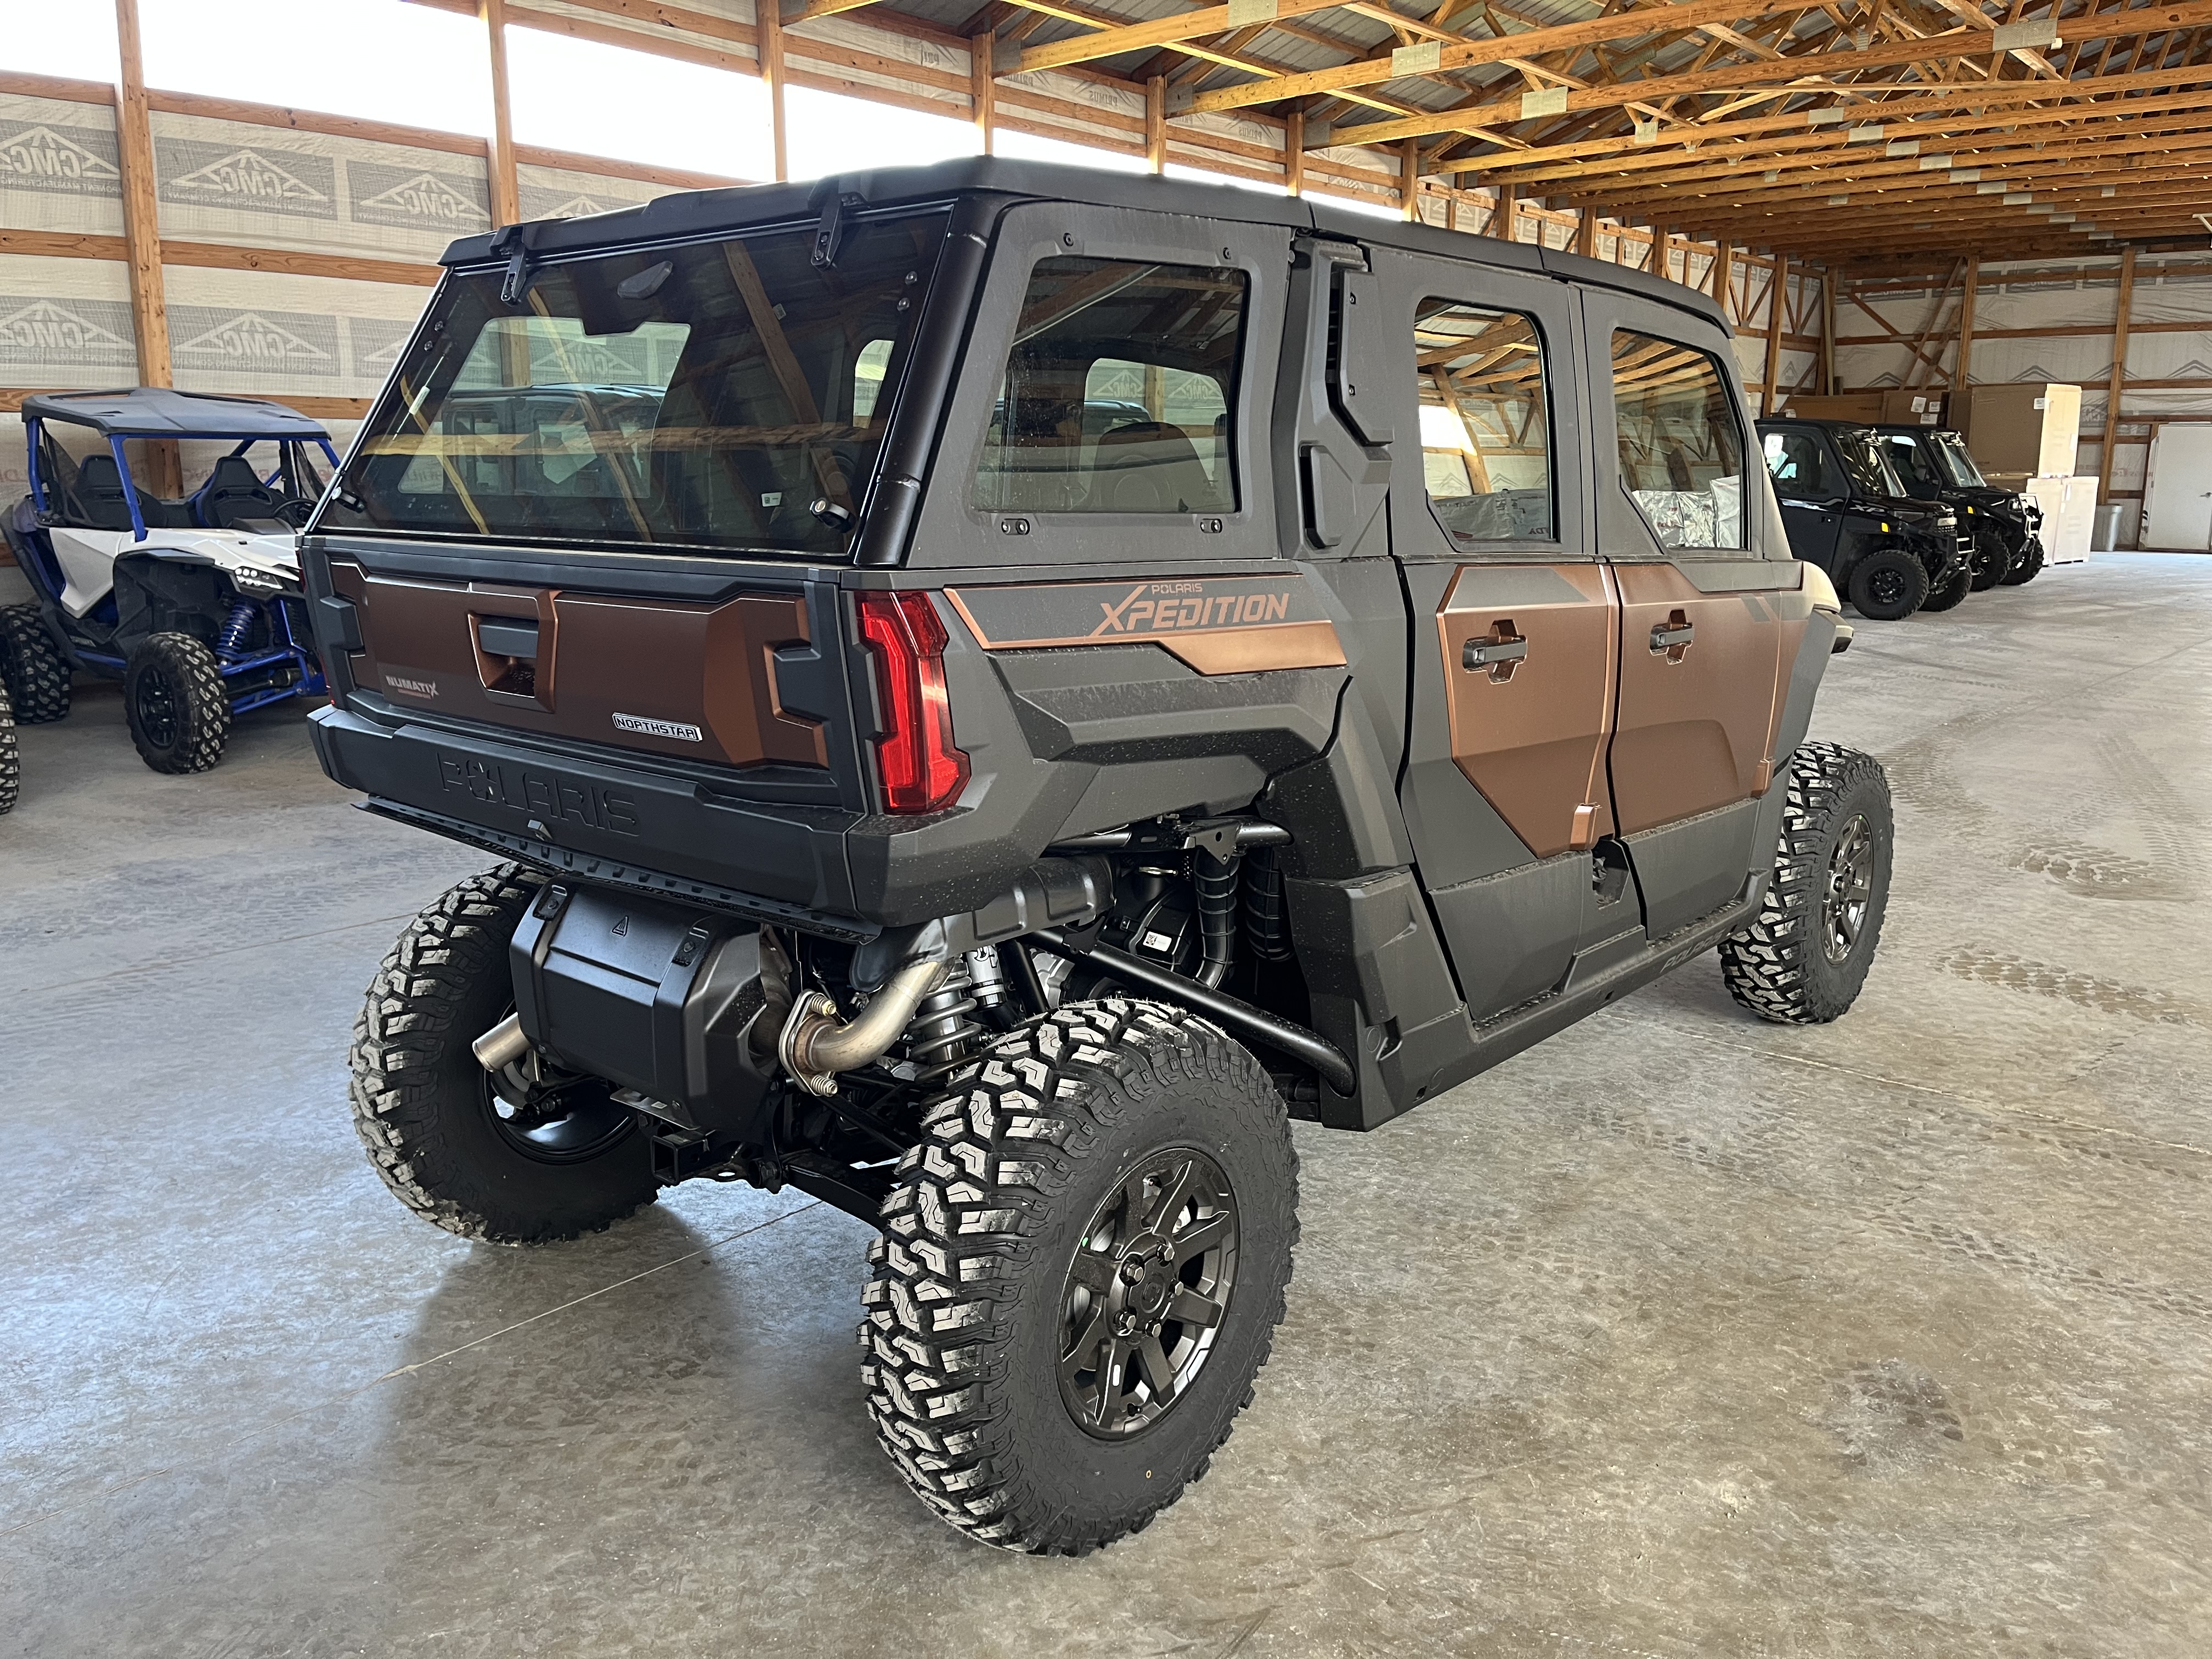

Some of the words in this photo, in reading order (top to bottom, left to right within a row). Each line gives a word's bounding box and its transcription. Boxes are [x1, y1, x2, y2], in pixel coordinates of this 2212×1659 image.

[1152, 583, 1203, 595] POLARIS
[1090, 585, 1289, 636] XPEDITION
[385, 675, 439, 699] NUMATIX
[616, 718, 695, 739] NORTHSTAR
[437, 752, 641, 838] POLARIS
[1660, 927, 1726, 974] POLARIS
